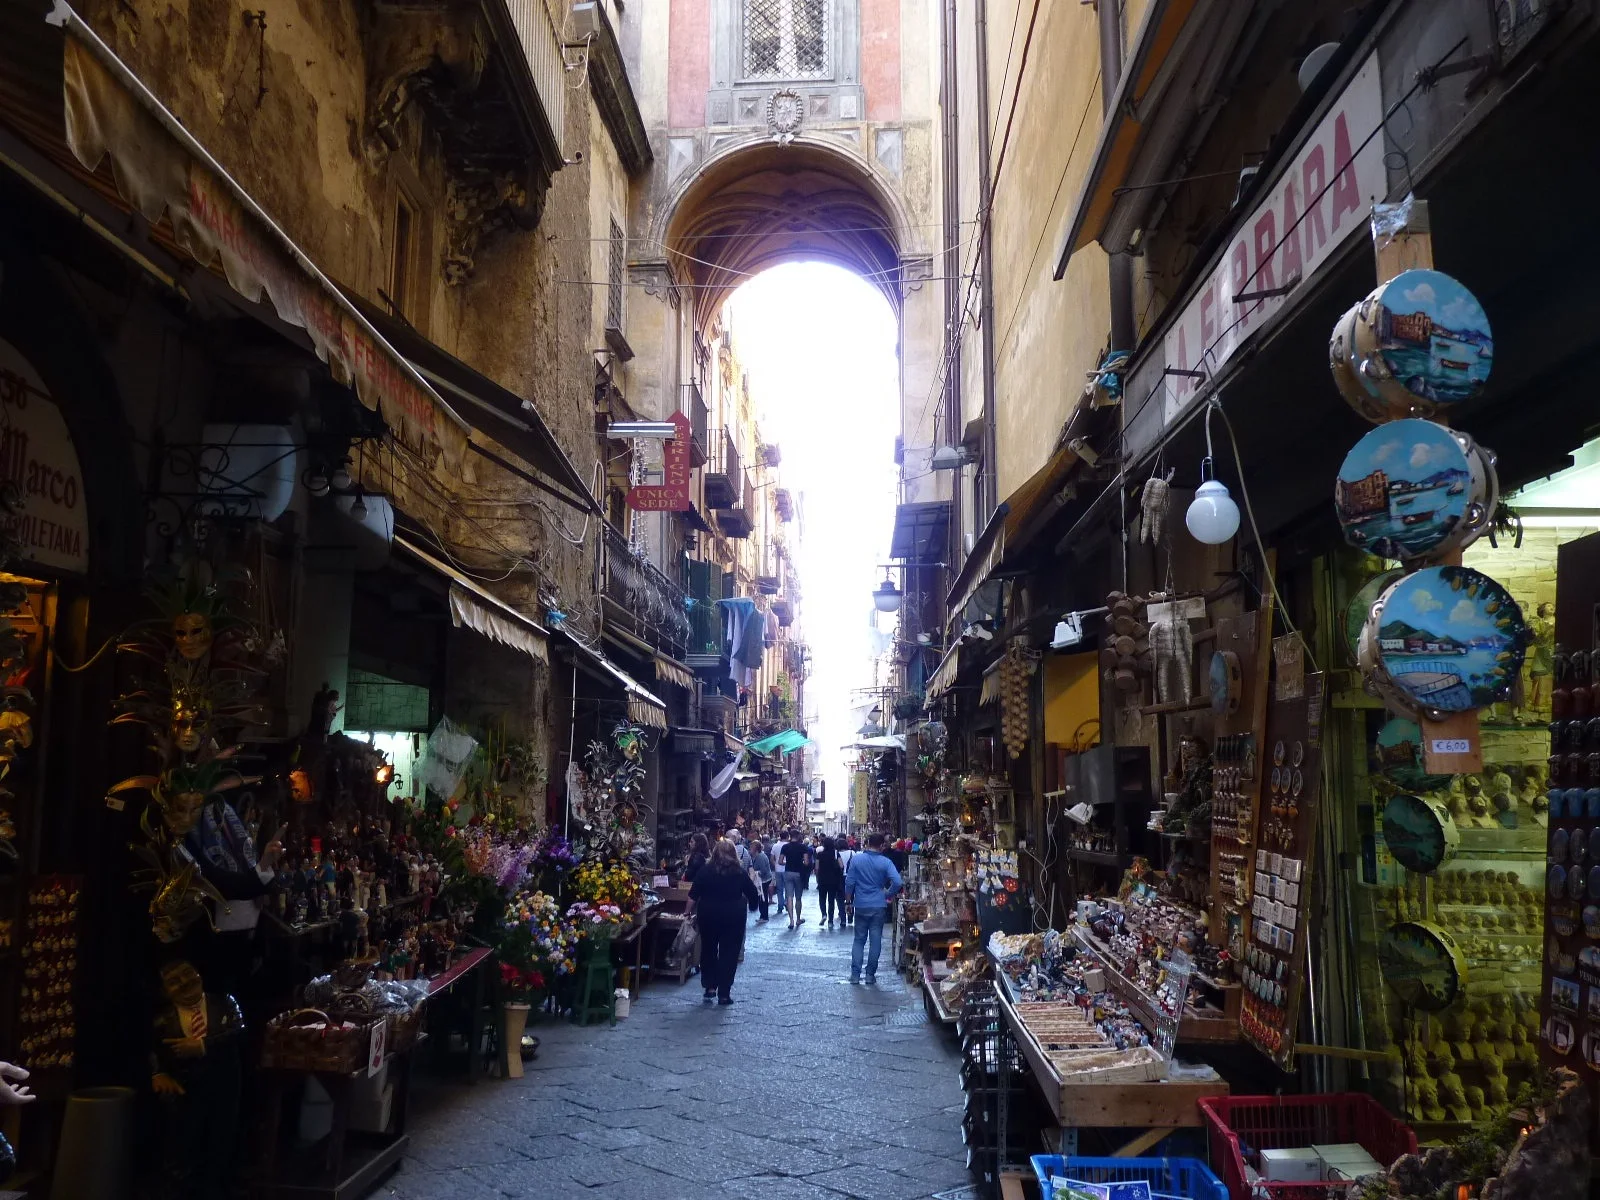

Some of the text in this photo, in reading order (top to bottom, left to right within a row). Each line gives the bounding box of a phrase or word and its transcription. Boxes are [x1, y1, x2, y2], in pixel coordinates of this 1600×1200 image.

[669, 425, 685, 486] FERRIGNO
[636, 488, 685, 499] UNICA
[639, 499, 679, 509] SEDE
